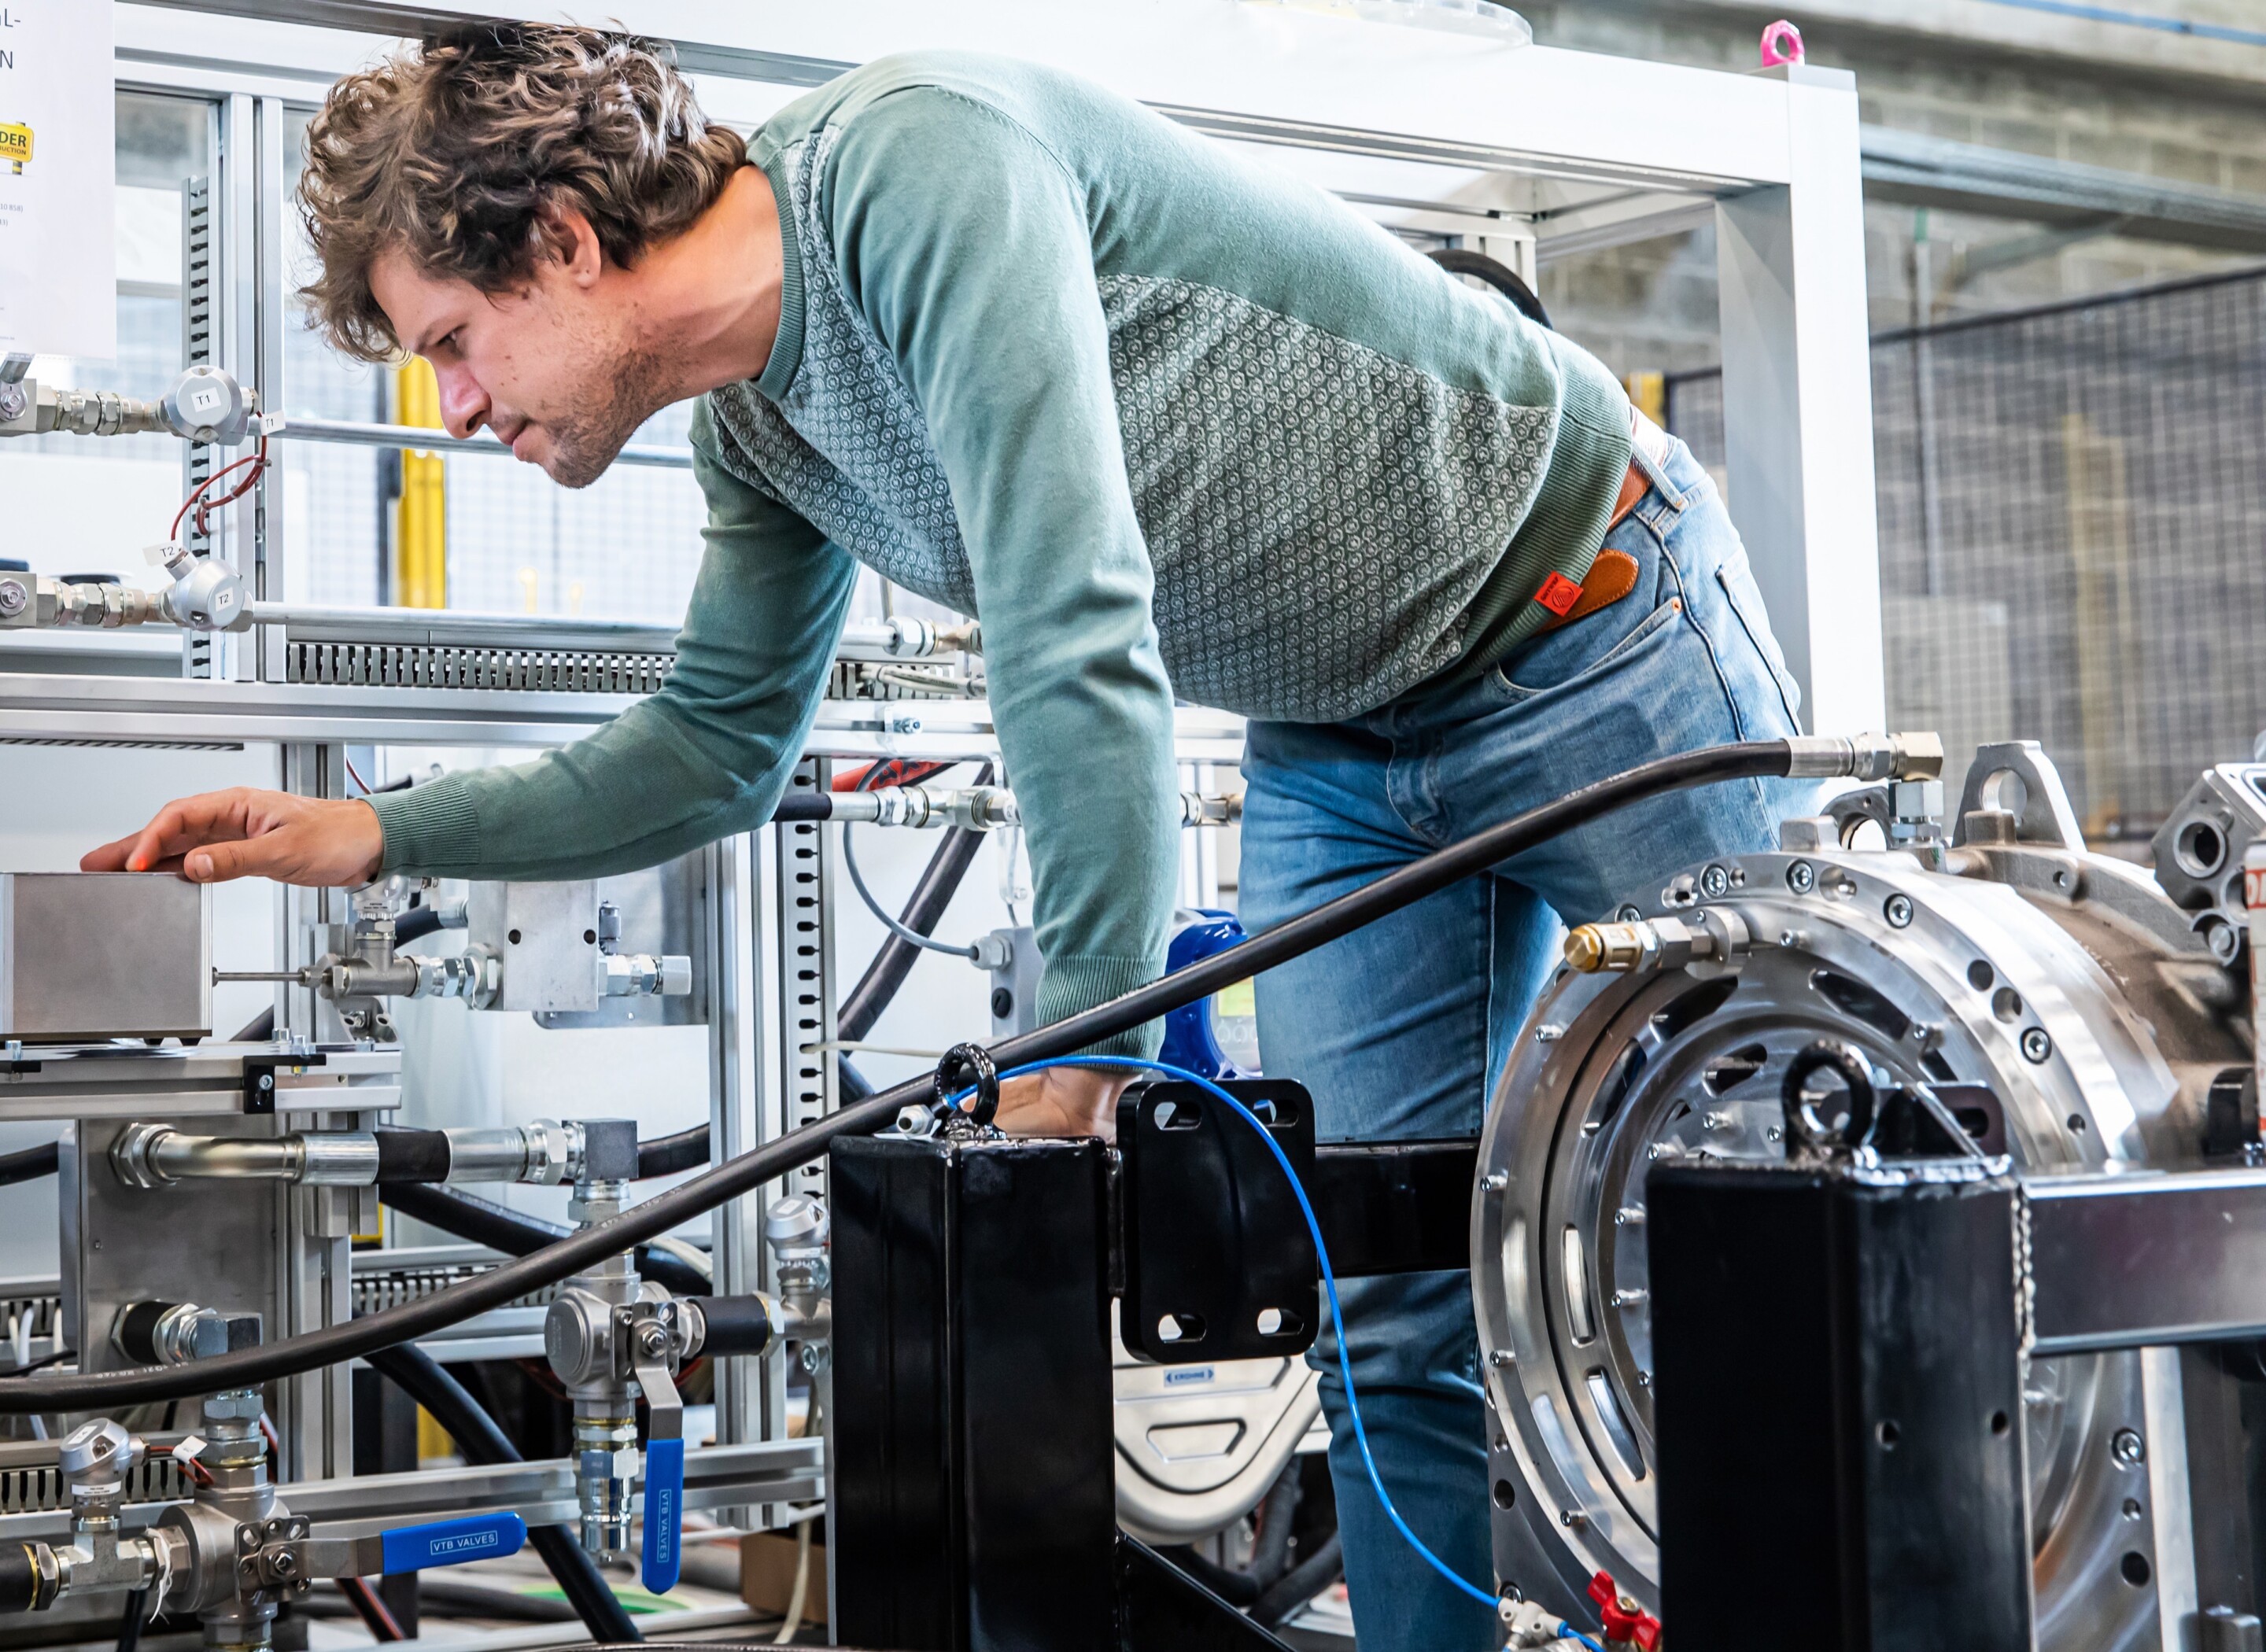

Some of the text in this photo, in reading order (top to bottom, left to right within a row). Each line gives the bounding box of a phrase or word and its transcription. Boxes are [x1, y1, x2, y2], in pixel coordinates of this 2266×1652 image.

[0, 8, 20, 28] L-
[0, 131, 27, 148] DER
[0, 146, 26, 155] UCTION
[196, 394, 210, 405] T1
[265, 418, 274, 429] T1
[160, 546, 175, 558] T2
[219, 594, 229, 605] T2
[434, 1533, 495, 1551] VTB VALVES
[659, 1518, 668, 1559] VALVES
